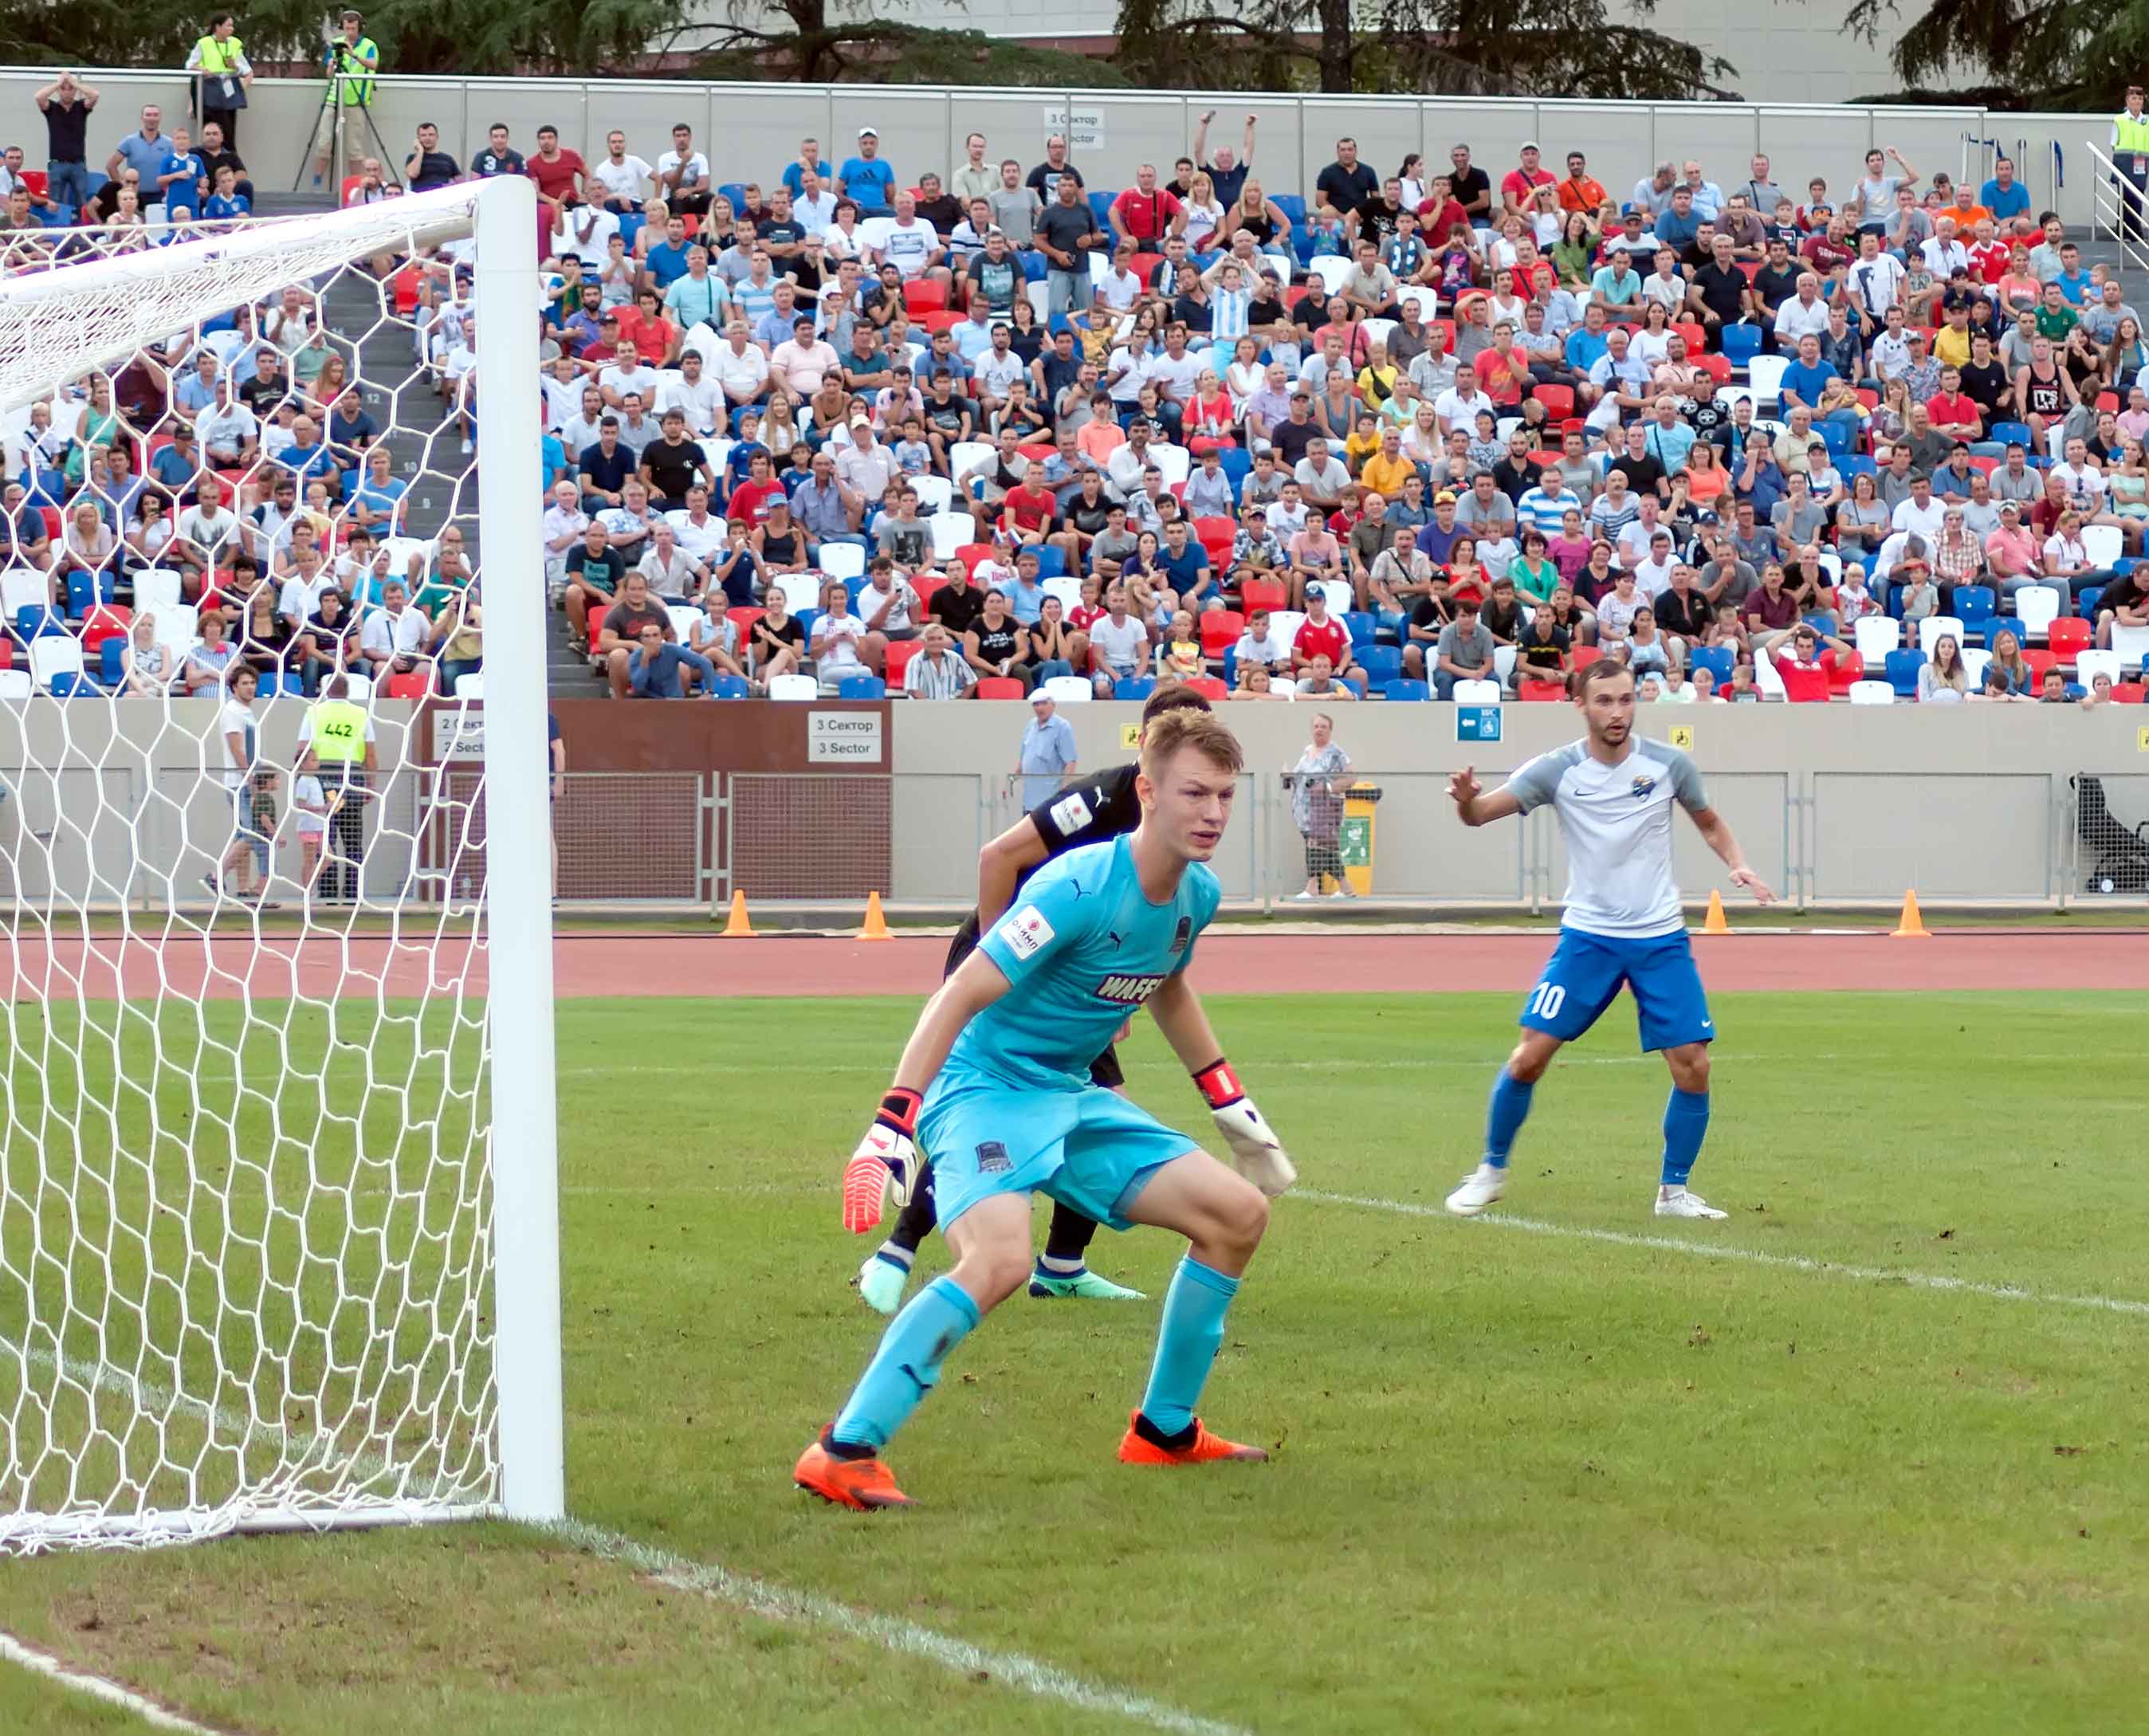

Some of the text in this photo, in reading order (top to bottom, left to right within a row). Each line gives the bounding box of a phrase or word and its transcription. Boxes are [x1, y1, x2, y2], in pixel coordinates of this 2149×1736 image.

[485, 155, 497, 171] 3
[442, 718, 450, 729] 2
[817, 720, 874, 732] 3 Сектор
[324, 724, 353, 737] 442
[819, 743, 871, 753] 3 Sector
[1530, 981, 1566, 1020] 10
